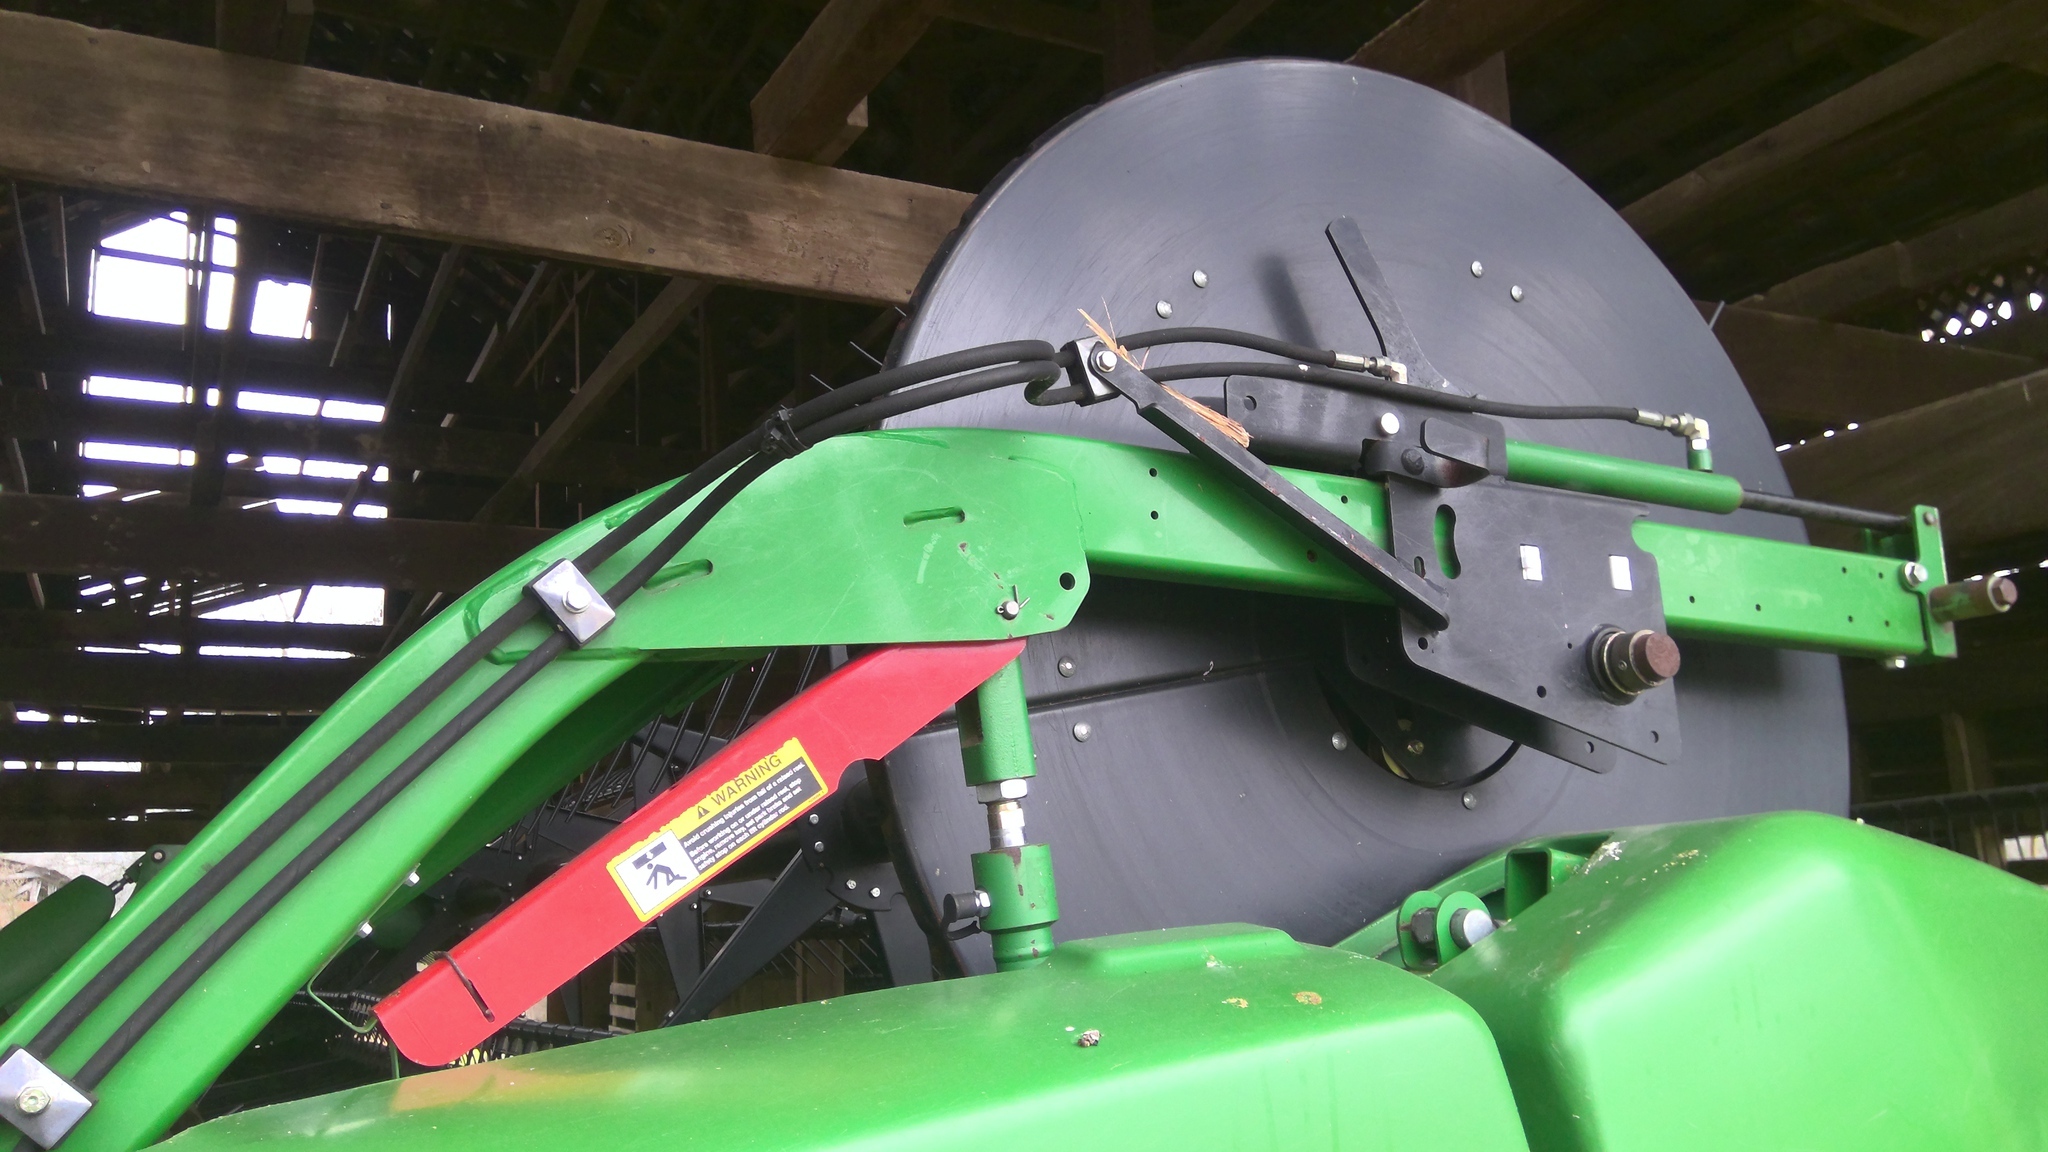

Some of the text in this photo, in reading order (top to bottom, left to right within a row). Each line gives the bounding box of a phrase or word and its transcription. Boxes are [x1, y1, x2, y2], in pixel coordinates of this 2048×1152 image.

[684, 833, 700, 848] Avoid
[700, 818, 725, 836] crushing
[723, 804, 745, 820] injuries
[744, 795, 758, 806] from
[757, 787, 767, 797] fall
[776, 769, 793, 784] raised
[793, 762, 805, 772] reel.
[711, 755, 781, 805] WARNING
[688, 842, 709, 857] Before
[708, 827, 731, 844] working
[745, 806, 761, 819] under
[760, 793, 778, 808] raised
[789, 778, 802, 788] stop
[693, 849, 715, 864] engine,
[714, 833, 735, 850] remove
[734, 826, 746, 835] key,
[754, 811, 768, 823] park
[766, 800, 782, 813] brake
[782, 792, 793, 802] and
[698, 856, 715, 871] safety
[715, 847, 728, 858] stop
[736, 832, 750, 844] each
[757, 812, 778, 829] cylinder
[778, 804, 790, 814] rod.
